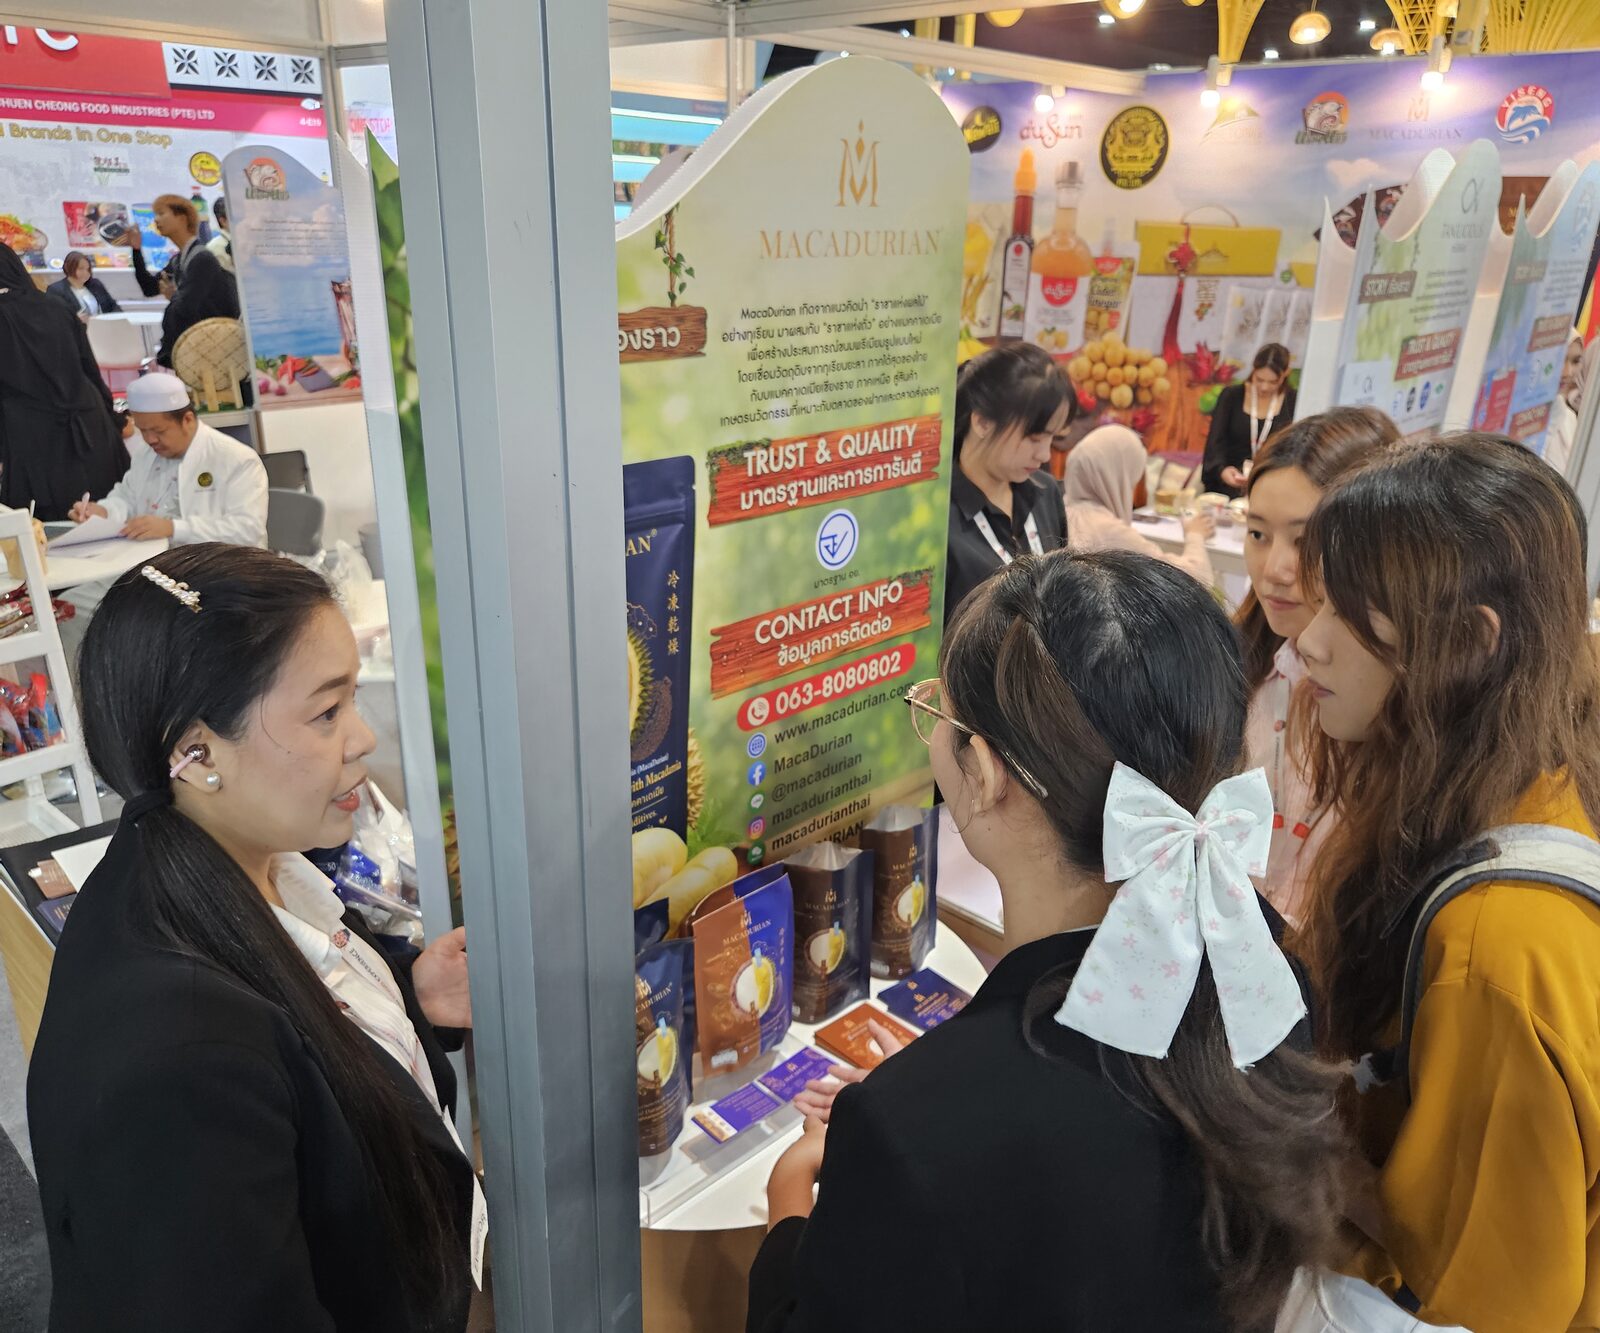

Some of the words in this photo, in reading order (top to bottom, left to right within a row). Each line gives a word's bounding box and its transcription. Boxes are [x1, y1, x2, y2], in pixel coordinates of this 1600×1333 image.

[0, 98, 32, 111] HUEN
[34, 99, 80, 113] CHEONG
[81, 102, 110, 114] FOOD
[111, 104, 169, 118] INDUSTRIES
[171, 107, 196, 120] (PTE)
[197, 109, 215, 120] LTD
[9, 122, 72, 140] Brands
[97, 128, 132, 144] One
[135, 130, 173, 149] Stop
[759, 227, 942, 260] MACADURIAN
[741, 306, 796, 320] MacaDurian
[744, 442, 808, 477] TRUST
[815, 437, 832, 464] &
[838, 424, 917, 459] QUALITY
[740, 451, 922, 510] มาตรฐานและการการันตี
[755, 594, 853, 644] CONTACT
[858, 580, 903, 614] INFO
[777, 611, 892, 667] ข้อมูลการติดต่อ
[775, 650, 902, 715] 063-8080802
[774, 681, 915, 745] www.macadurian.com
[771, 751, 862, 802] @macadurian
[774, 732, 853, 775] MacaDurian
[631, 777, 645, 792] ith
[771, 769, 873, 826] macadurianthai
[771, 794, 872, 850] macadurianthai
